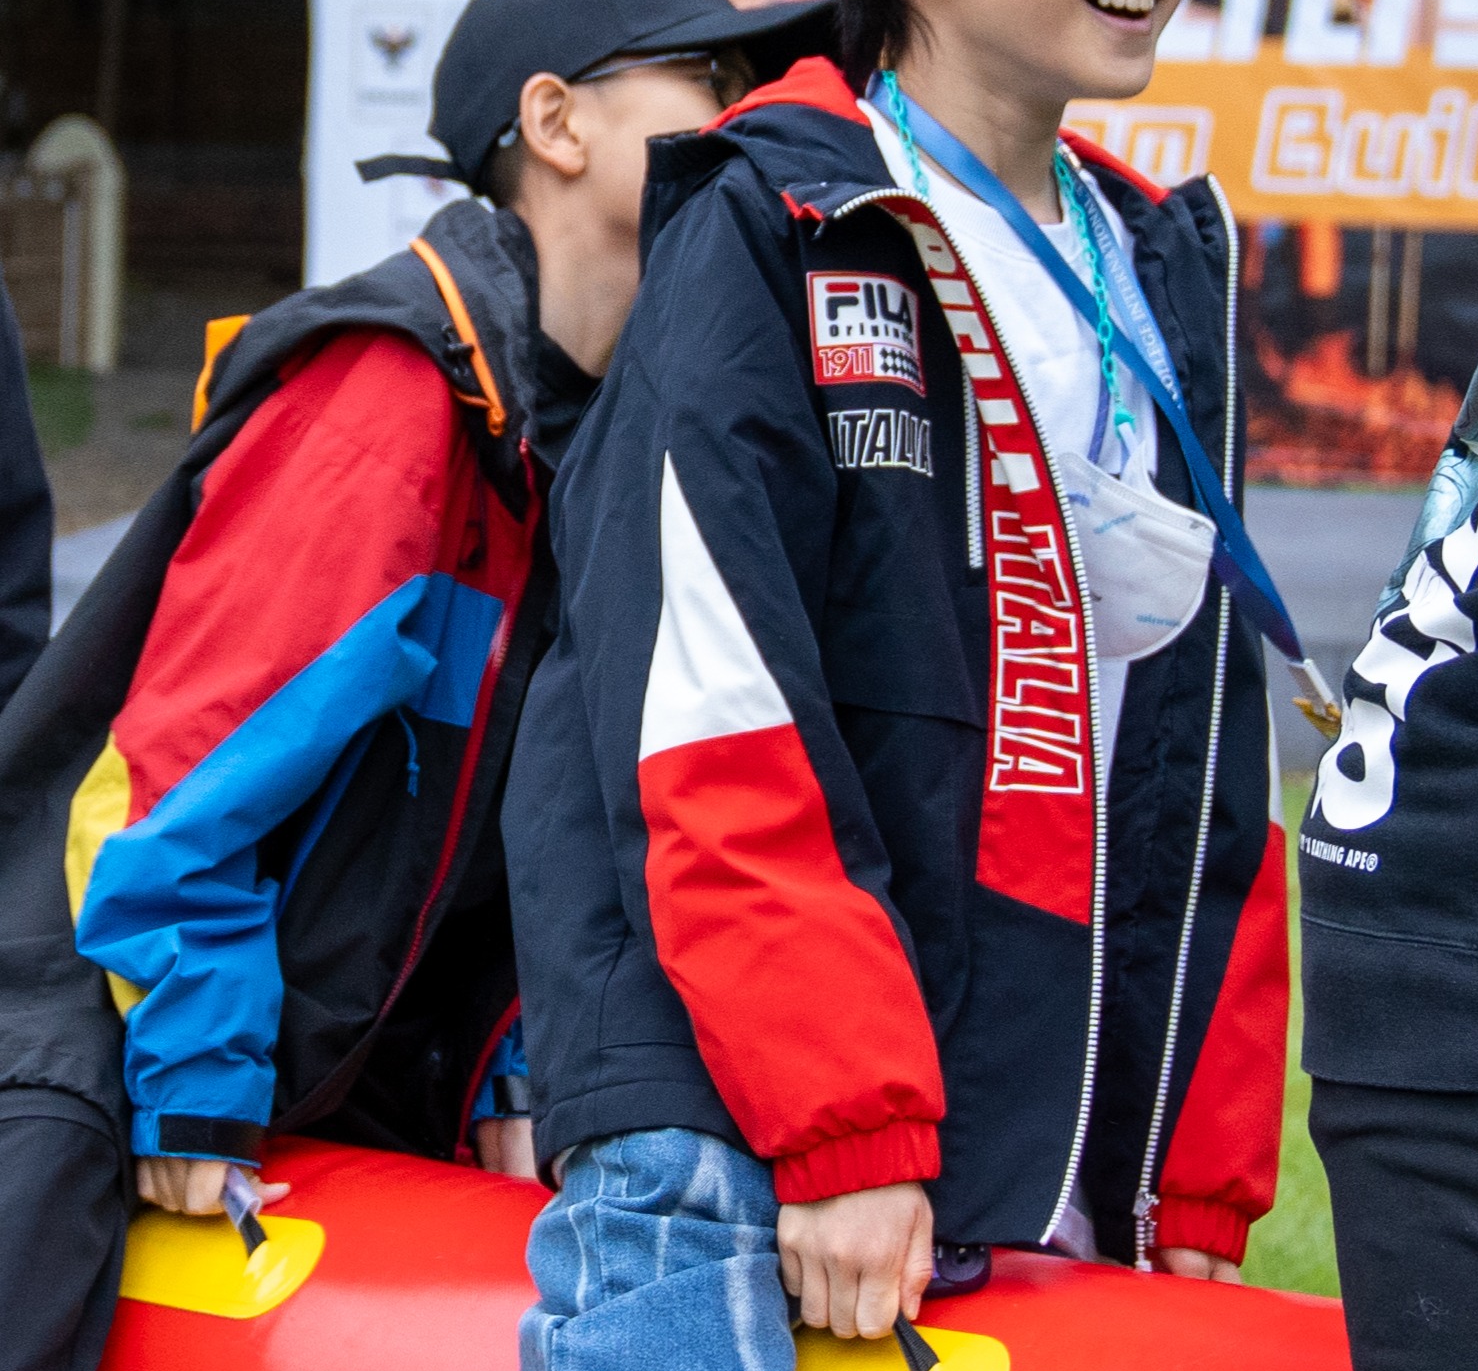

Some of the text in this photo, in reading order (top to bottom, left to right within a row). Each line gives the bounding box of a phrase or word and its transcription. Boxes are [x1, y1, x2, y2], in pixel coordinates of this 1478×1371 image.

[825, 281, 912, 333] FILA
[818, 345, 874, 379] 1911
[827, 408, 934, 477] ITALIA
[988, 510, 1084, 794] ITALIA
